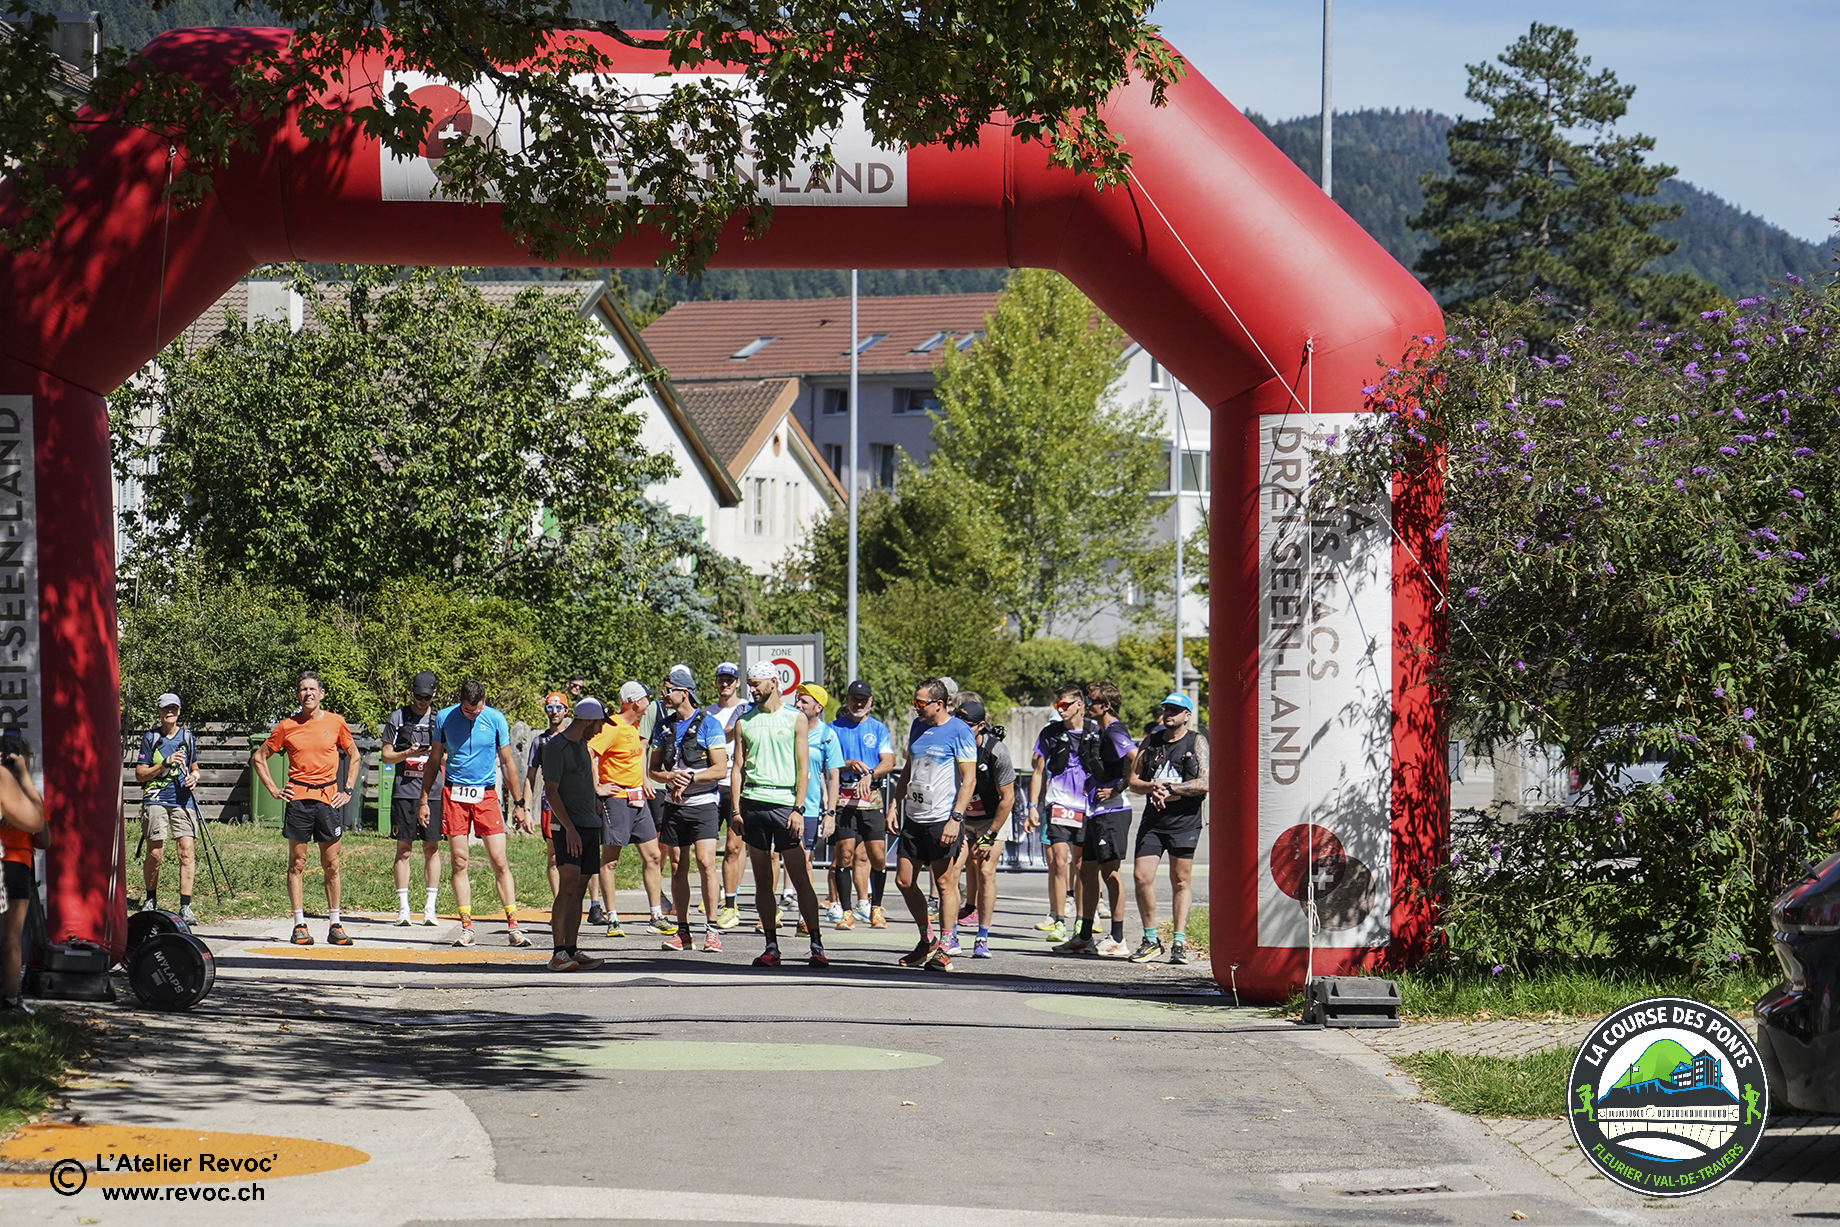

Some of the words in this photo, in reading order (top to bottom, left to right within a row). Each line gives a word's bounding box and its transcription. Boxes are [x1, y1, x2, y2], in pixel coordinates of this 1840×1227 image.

[1307, 424, 1340, 681] TIS-LACS
[0, 407, 29, 729] REI-SEEN-LAND
[1271, 427, 1302, 785] DREI-SEEN-LAND
[771, 648, 792, 656] ZONE
[777, 670, 790, 683] 0
[459, 786, 477, 798] 110
[912, 792, 924, 803] 95
[1061, 809, 1075, 819] 30
[153, 950, 184, 994] MYLAPS
